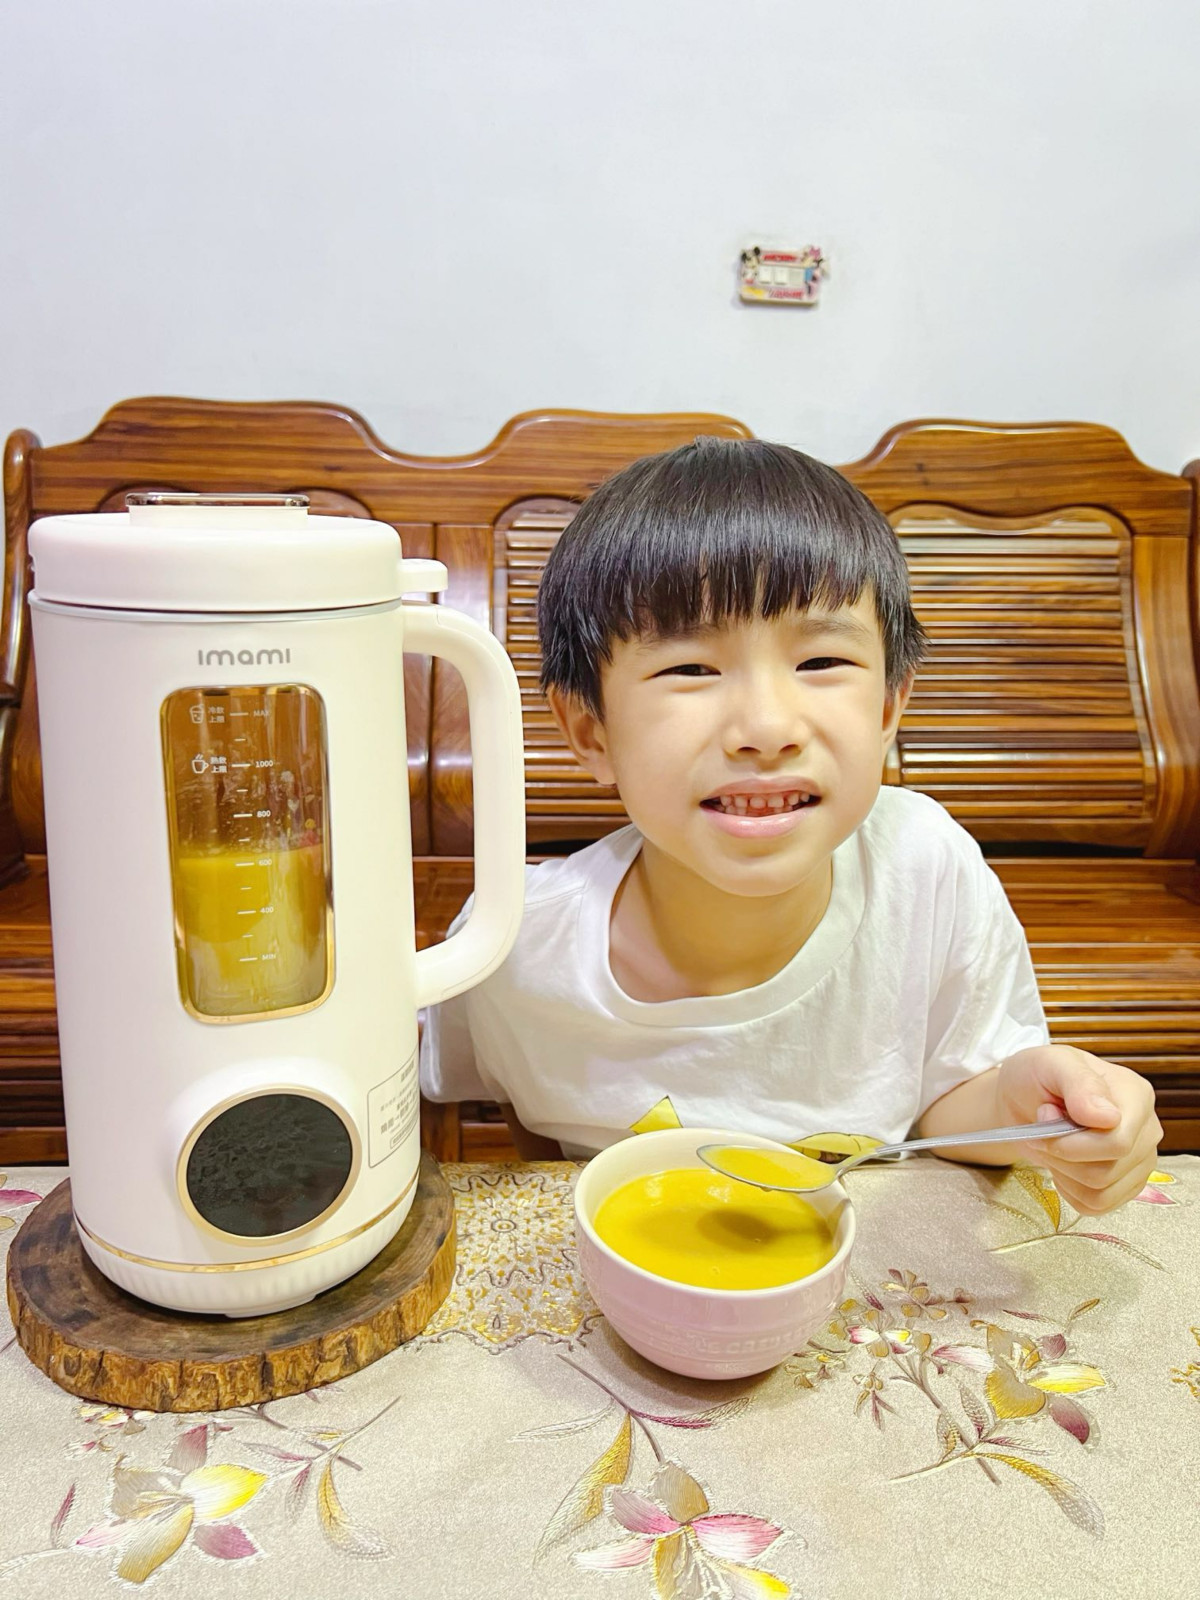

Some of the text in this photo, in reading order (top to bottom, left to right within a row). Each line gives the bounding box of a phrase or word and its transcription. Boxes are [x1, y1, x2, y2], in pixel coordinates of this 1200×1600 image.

[255, 760, 274, 768] 1000
[257, 810, 271, 818] 800
[259, 859, 272, 867] 600
[260, 906, 274, 914] 400
